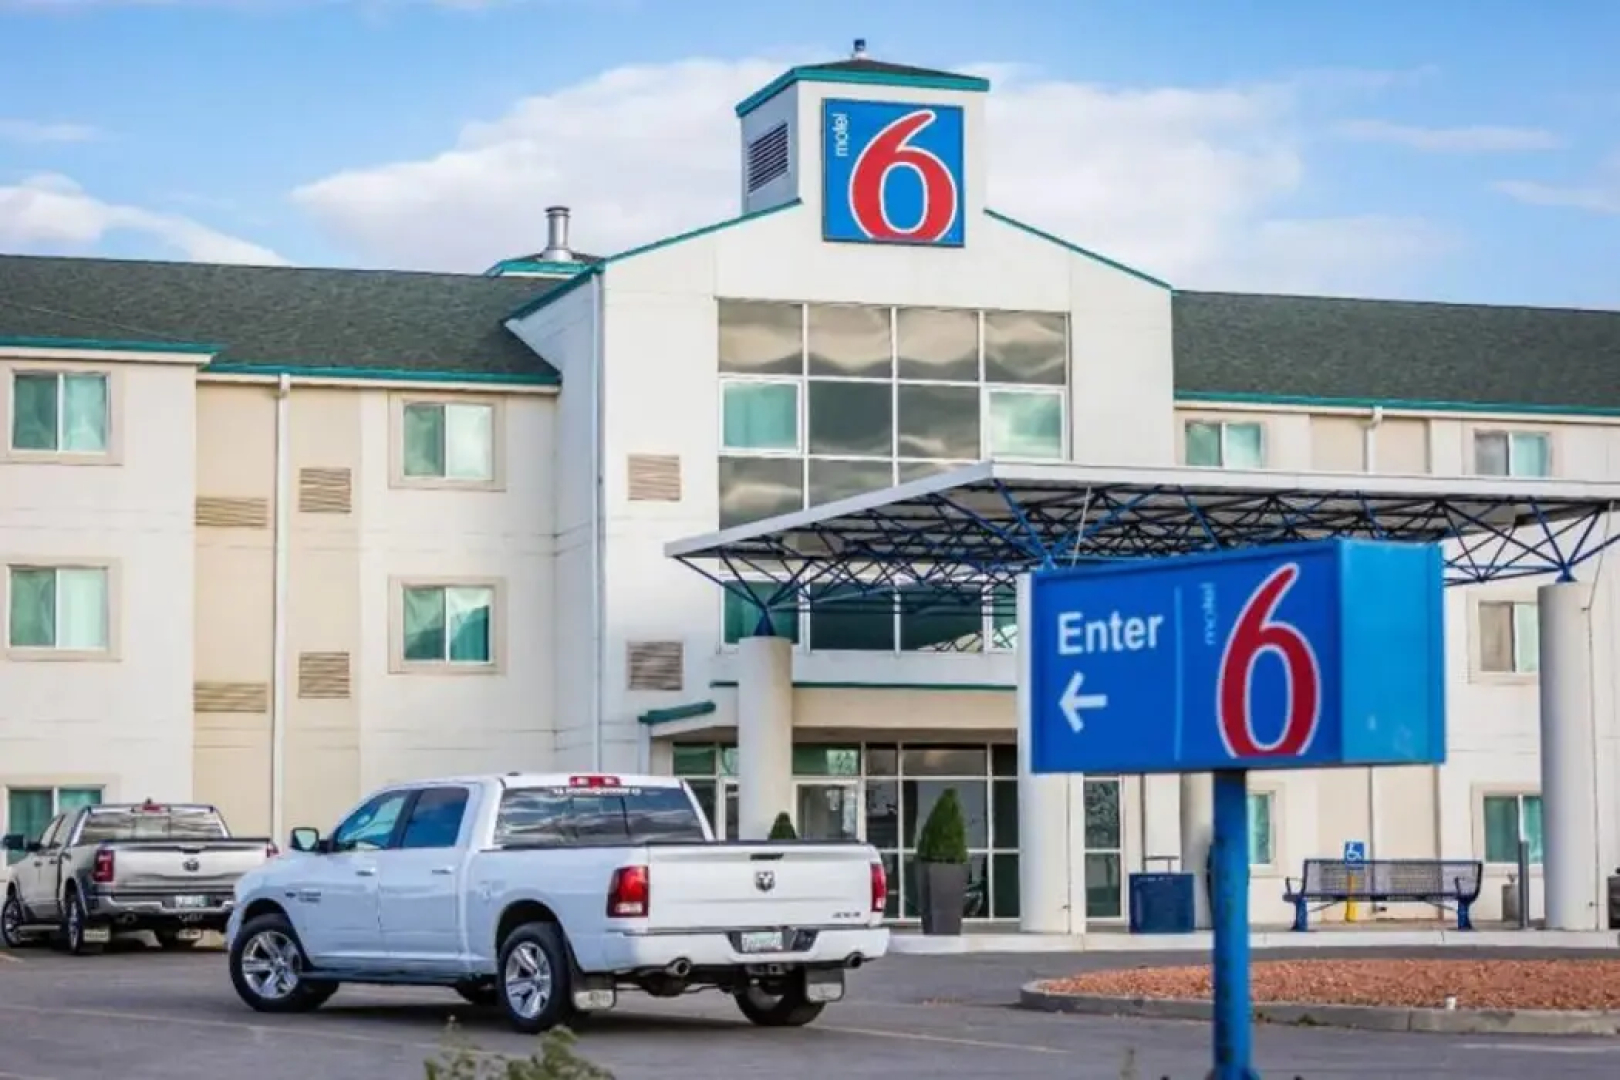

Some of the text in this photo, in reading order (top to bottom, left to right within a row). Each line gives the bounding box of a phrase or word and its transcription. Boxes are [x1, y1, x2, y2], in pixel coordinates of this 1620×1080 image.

[832, 109, 957, 242] motel 6
[1057, 610, 1163, 655] Enter
[1216, 562, 1321, 758] 6
